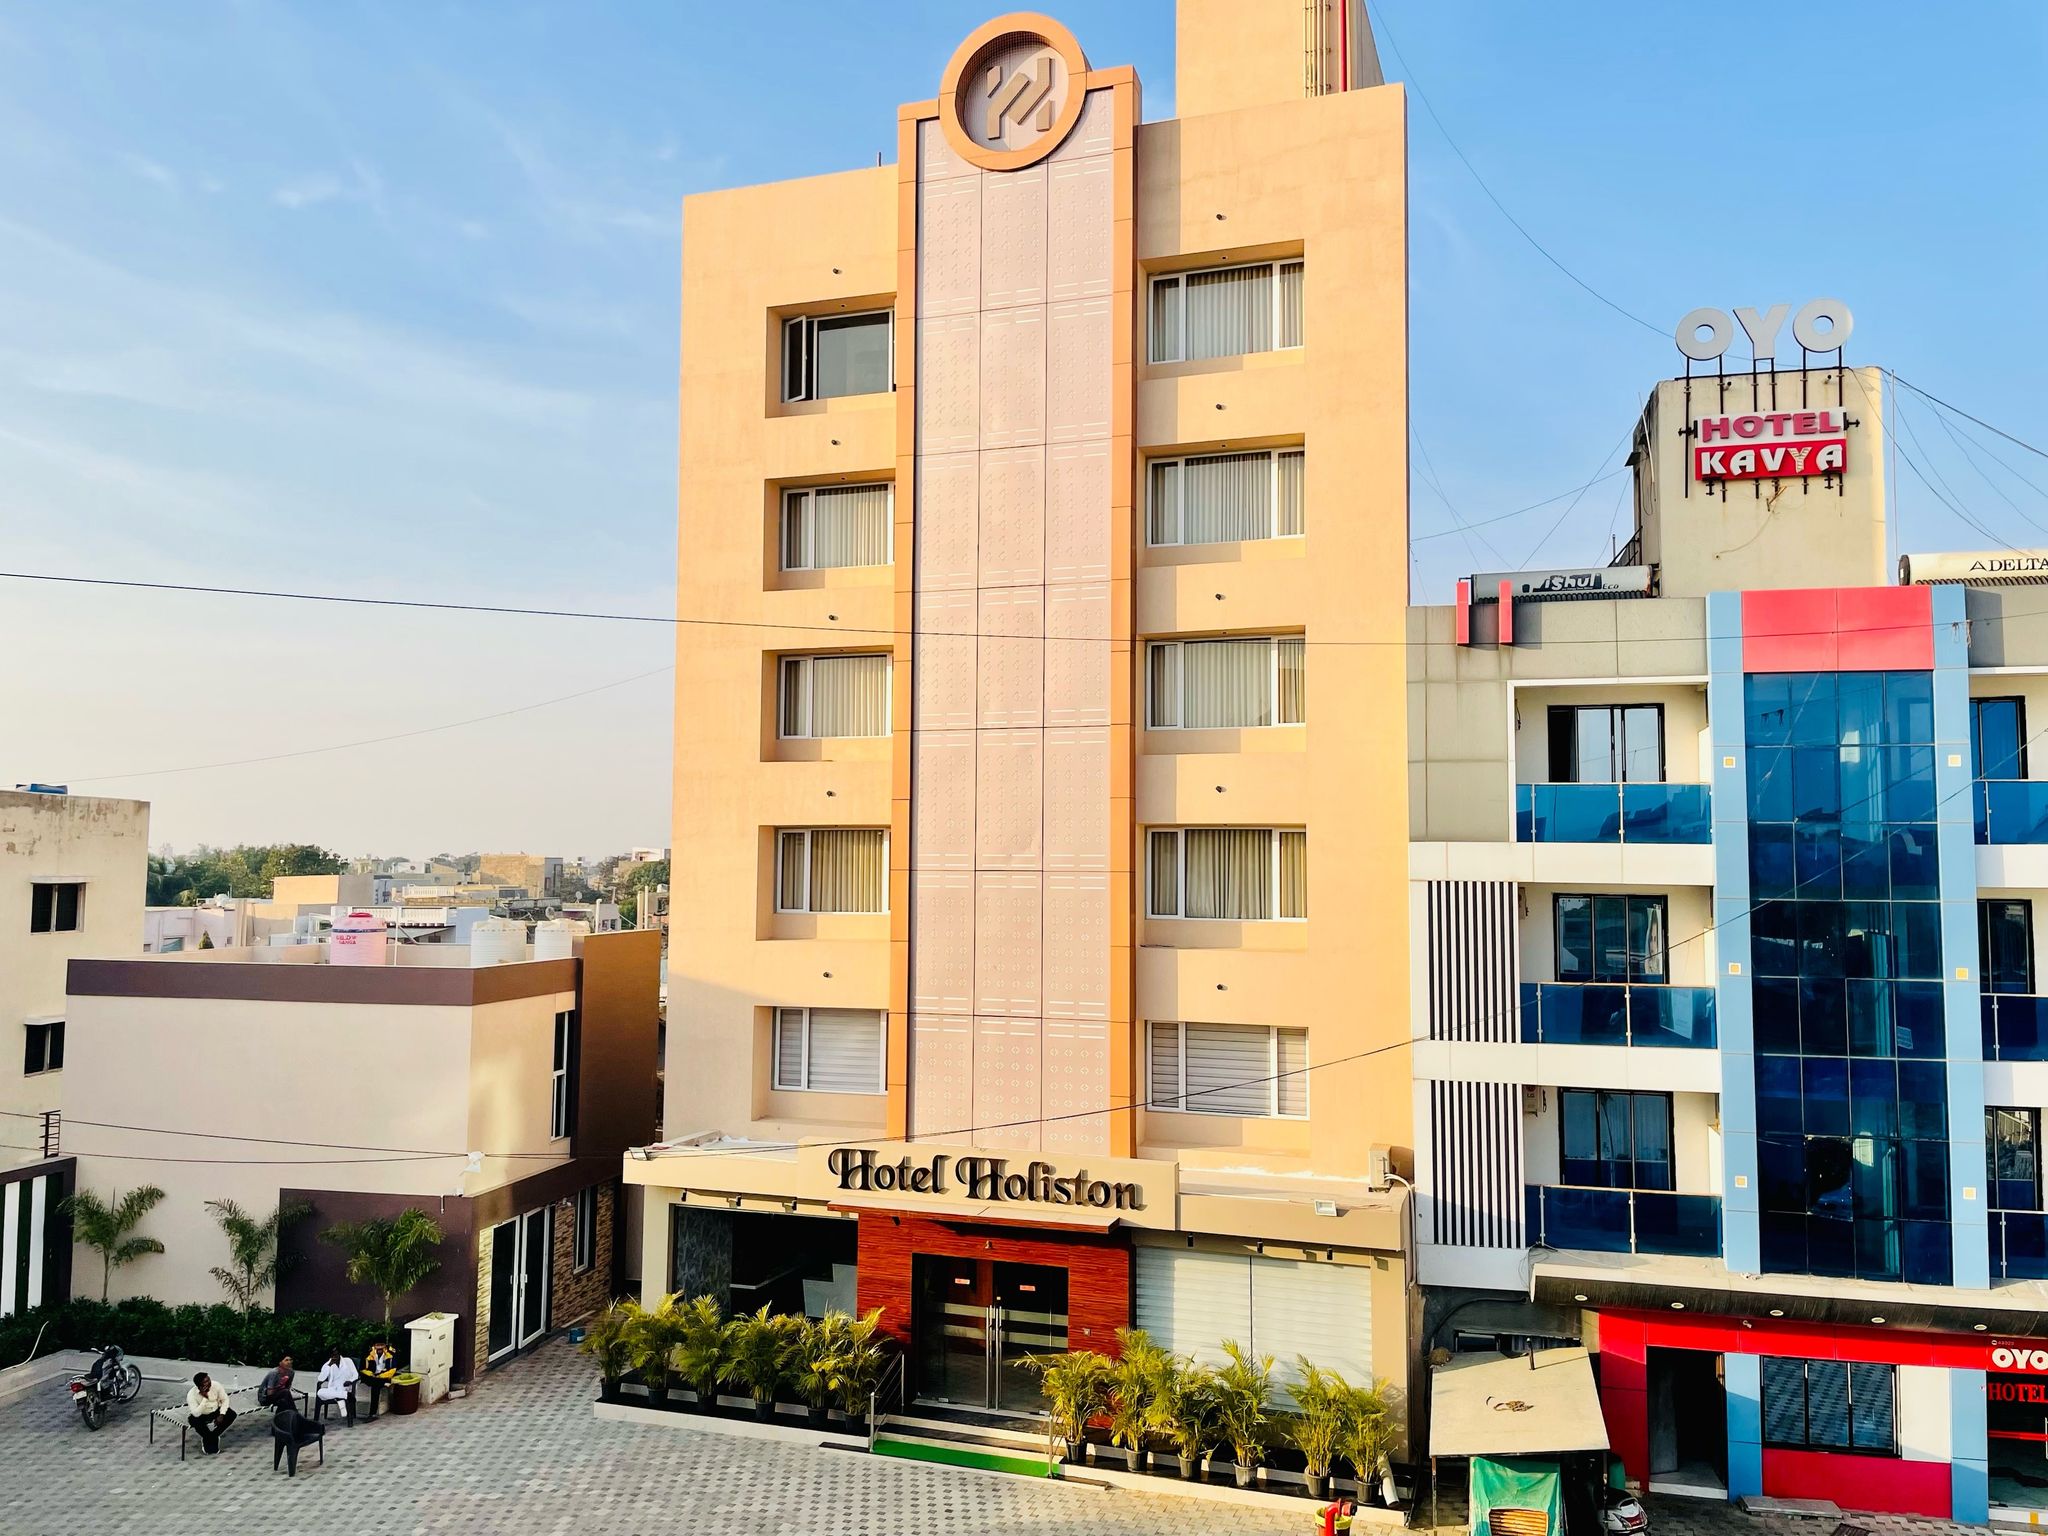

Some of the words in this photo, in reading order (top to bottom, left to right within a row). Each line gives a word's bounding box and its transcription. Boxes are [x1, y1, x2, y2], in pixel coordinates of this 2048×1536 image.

[1675, 297, 1854, 361] OYO
[1702, 411, 1842, 443] HOTEL
[1701, 444, 1843, 476] KAVYA
[828, 1148, 951, 1194] Hotel
[955, 1156, 1147, 1211] Holiston
[1991, 1348, 2048, 1370] OYO
[1987, 1382, 2048, 1403] HOTEL
